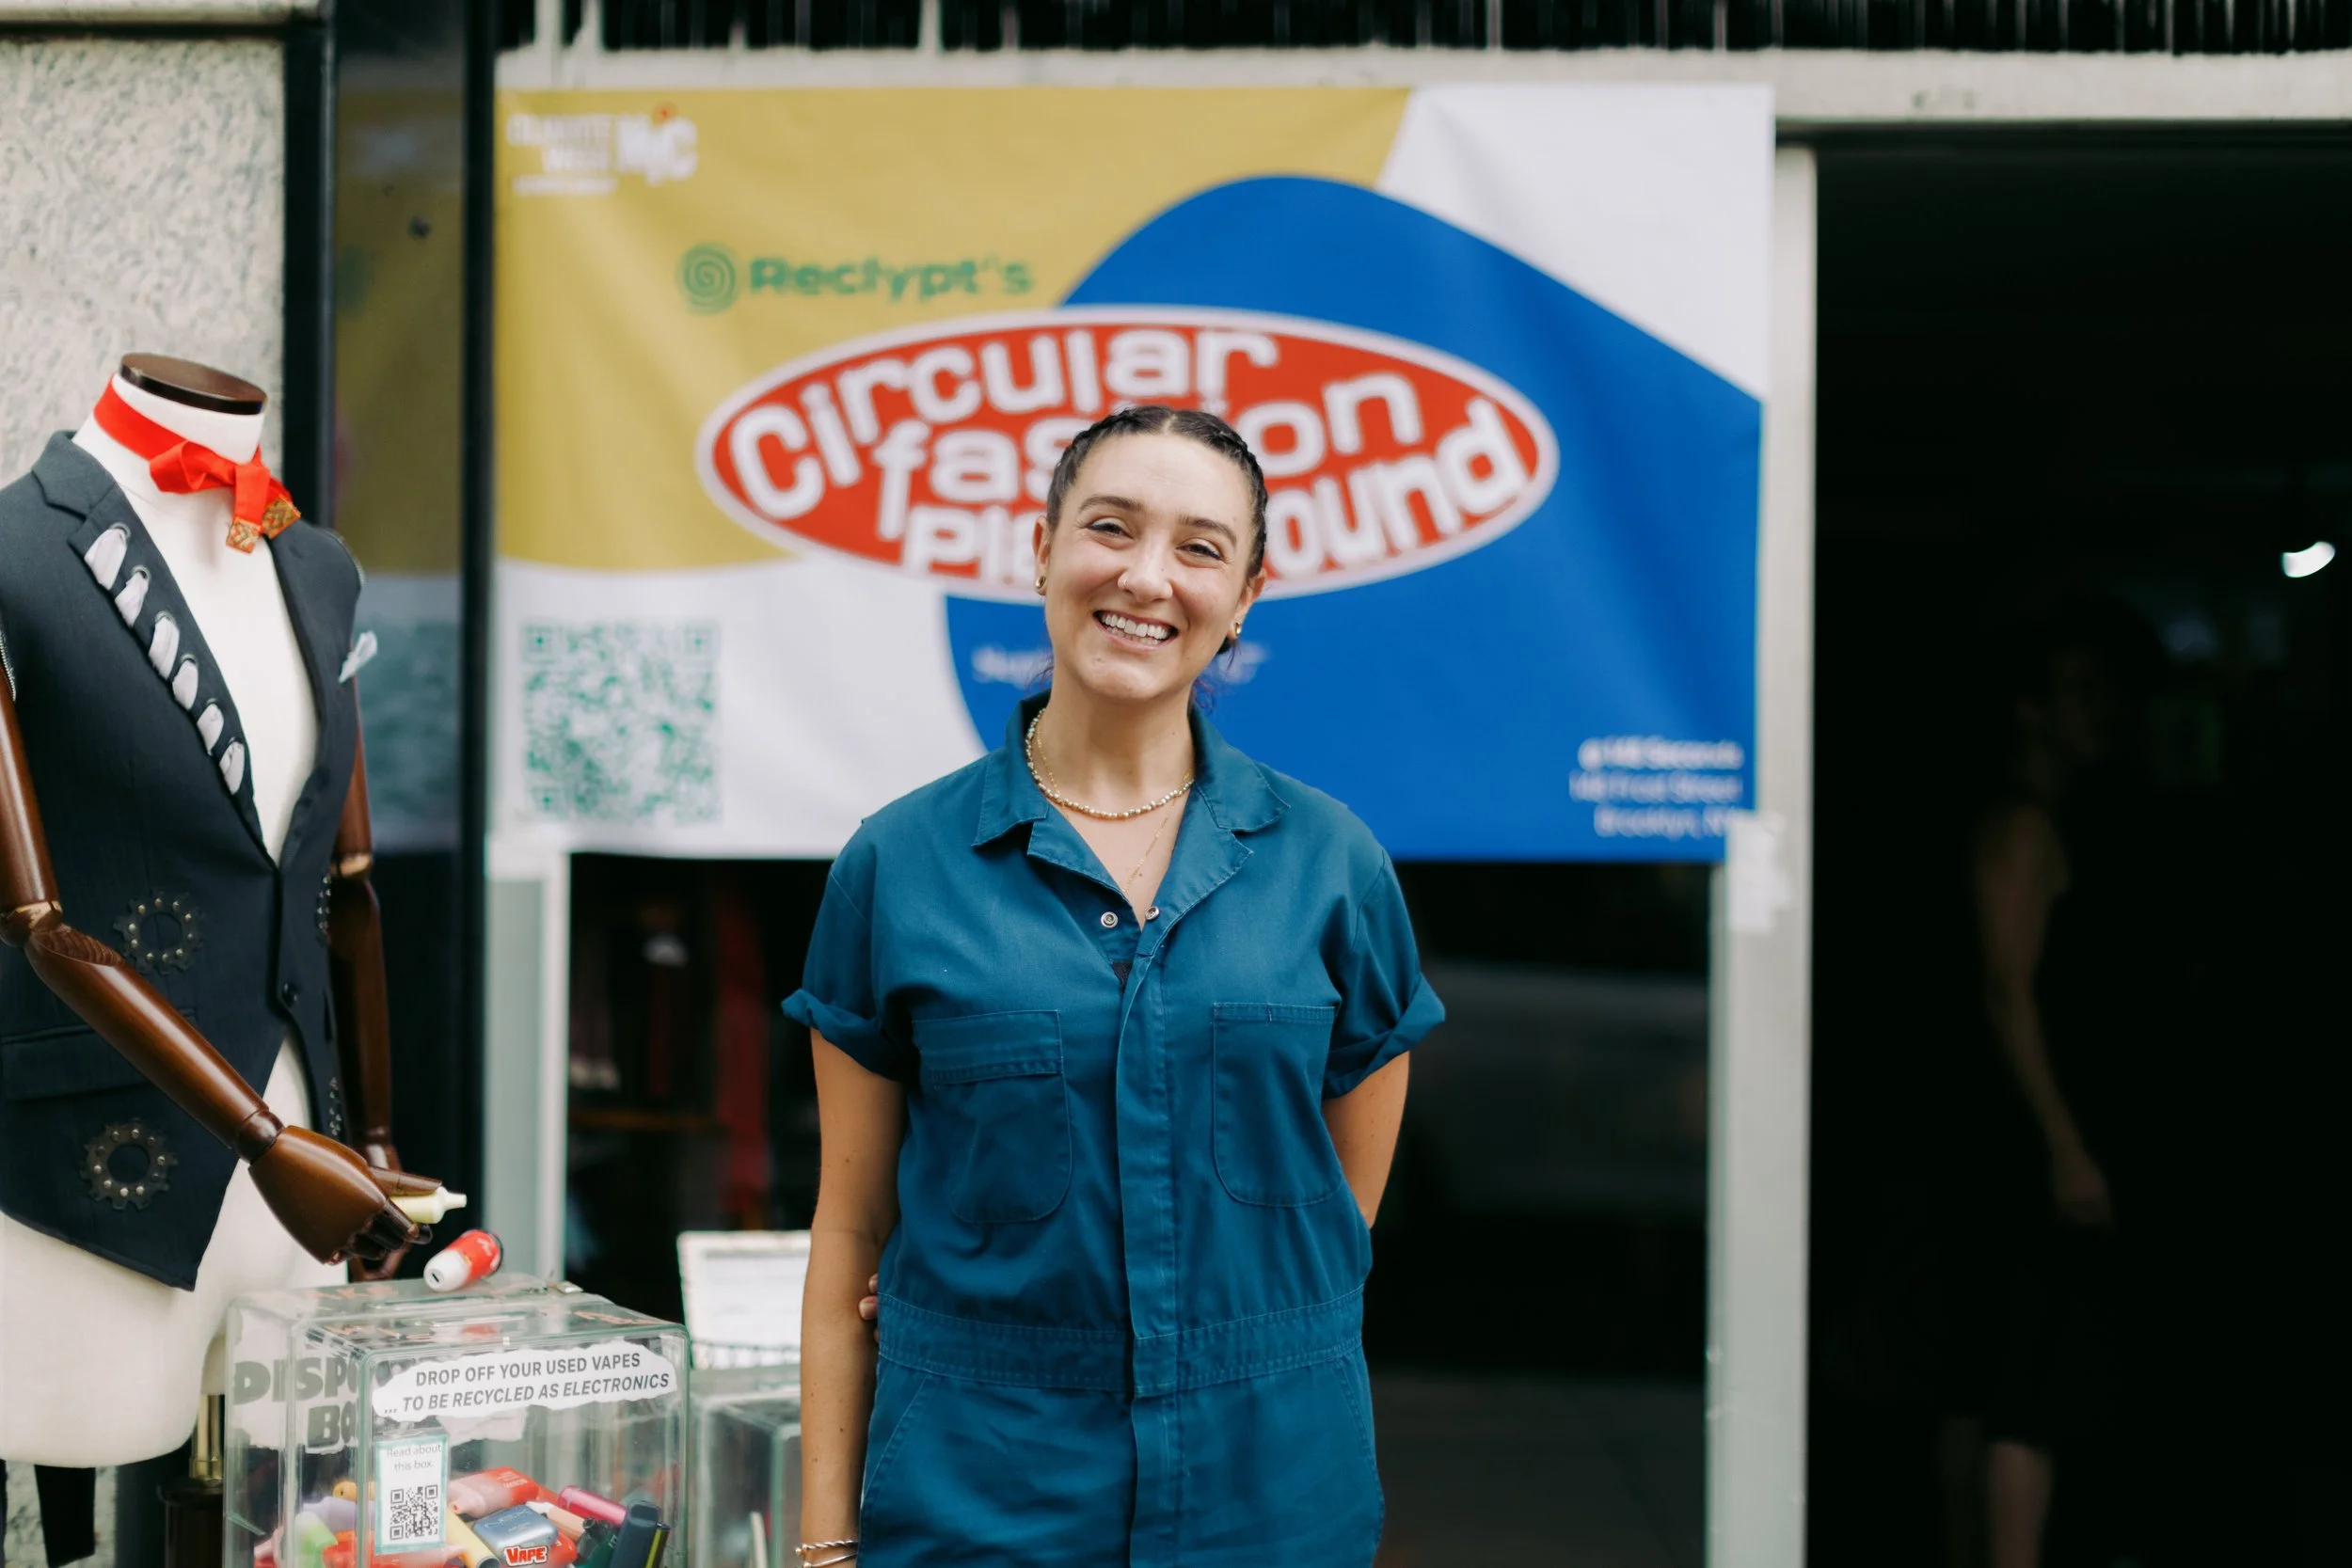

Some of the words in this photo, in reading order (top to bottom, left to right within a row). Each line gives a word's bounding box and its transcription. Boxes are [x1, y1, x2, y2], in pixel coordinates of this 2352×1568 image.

[730, 328, 1280, 520] Circular
[871, 372, 1425, 542] fason
[415, 1369, 460, 1387] DROP
[465, 1366, 496, 1383] OFF
[500, 1361, 542, 1380] YOUR
[547, 1357, 587, 1375] USED
[592, 1353, 641, 1370] VAPES
[403, 1396, 424, 1413] TO
[428, 1393, 449, 1410] BE
[452, 1386, 534, 1408] RECYCLED
[538, 1383, 559, 1400] AS
[563, 1373, 670, 1397] ELECTRONICS
[387, 1446, 411, 1458] Read
[413, 1444, 441, 1456] about
[394, 1462, 412, 1471] this
[414, 1460, 435, 1469] box.
[505, 1546, 547, 1564] VAPE
